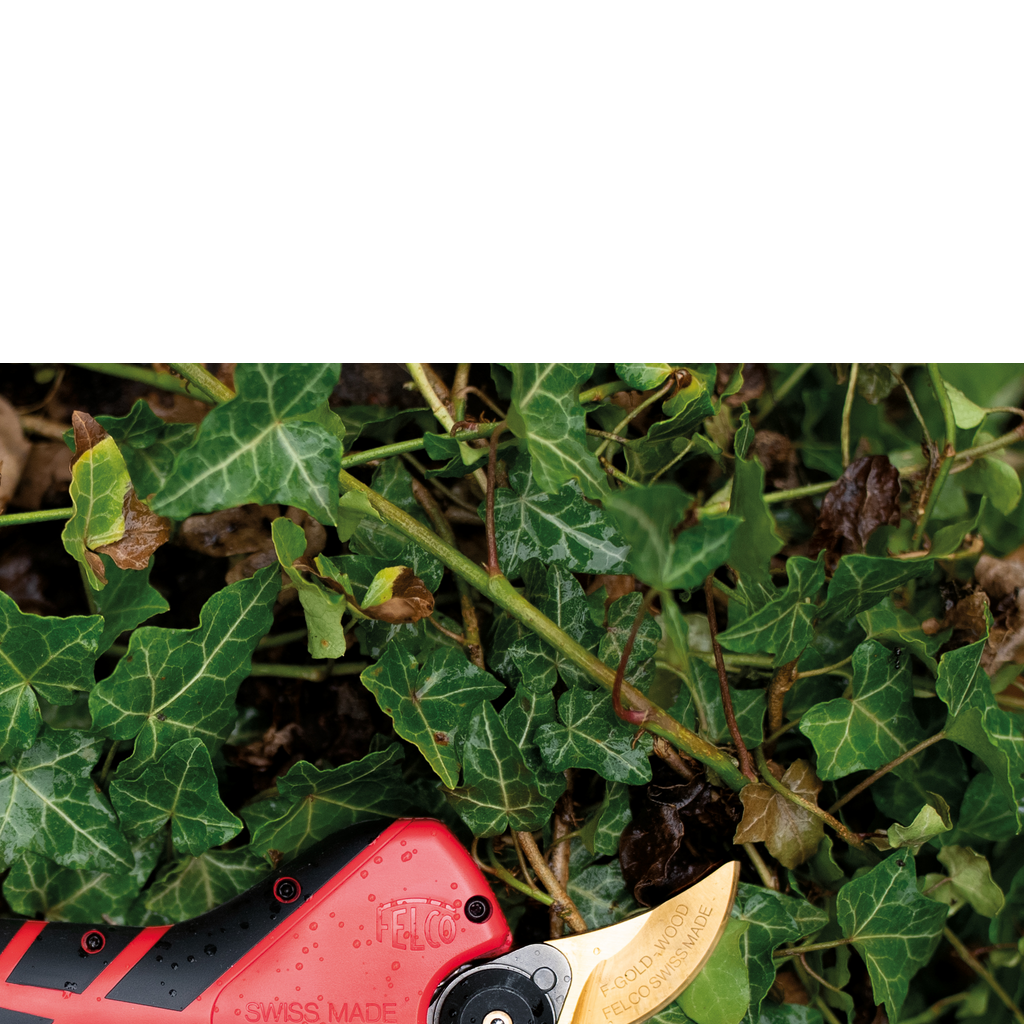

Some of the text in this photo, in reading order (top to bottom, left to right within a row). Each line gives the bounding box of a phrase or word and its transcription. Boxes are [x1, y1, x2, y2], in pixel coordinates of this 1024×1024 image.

[376, 897, 457, 951] FELCO
[602, 904, 714, 1020] FELCO SWISS MADE
[245, 1002, 398, 1024] SWISS MADE
